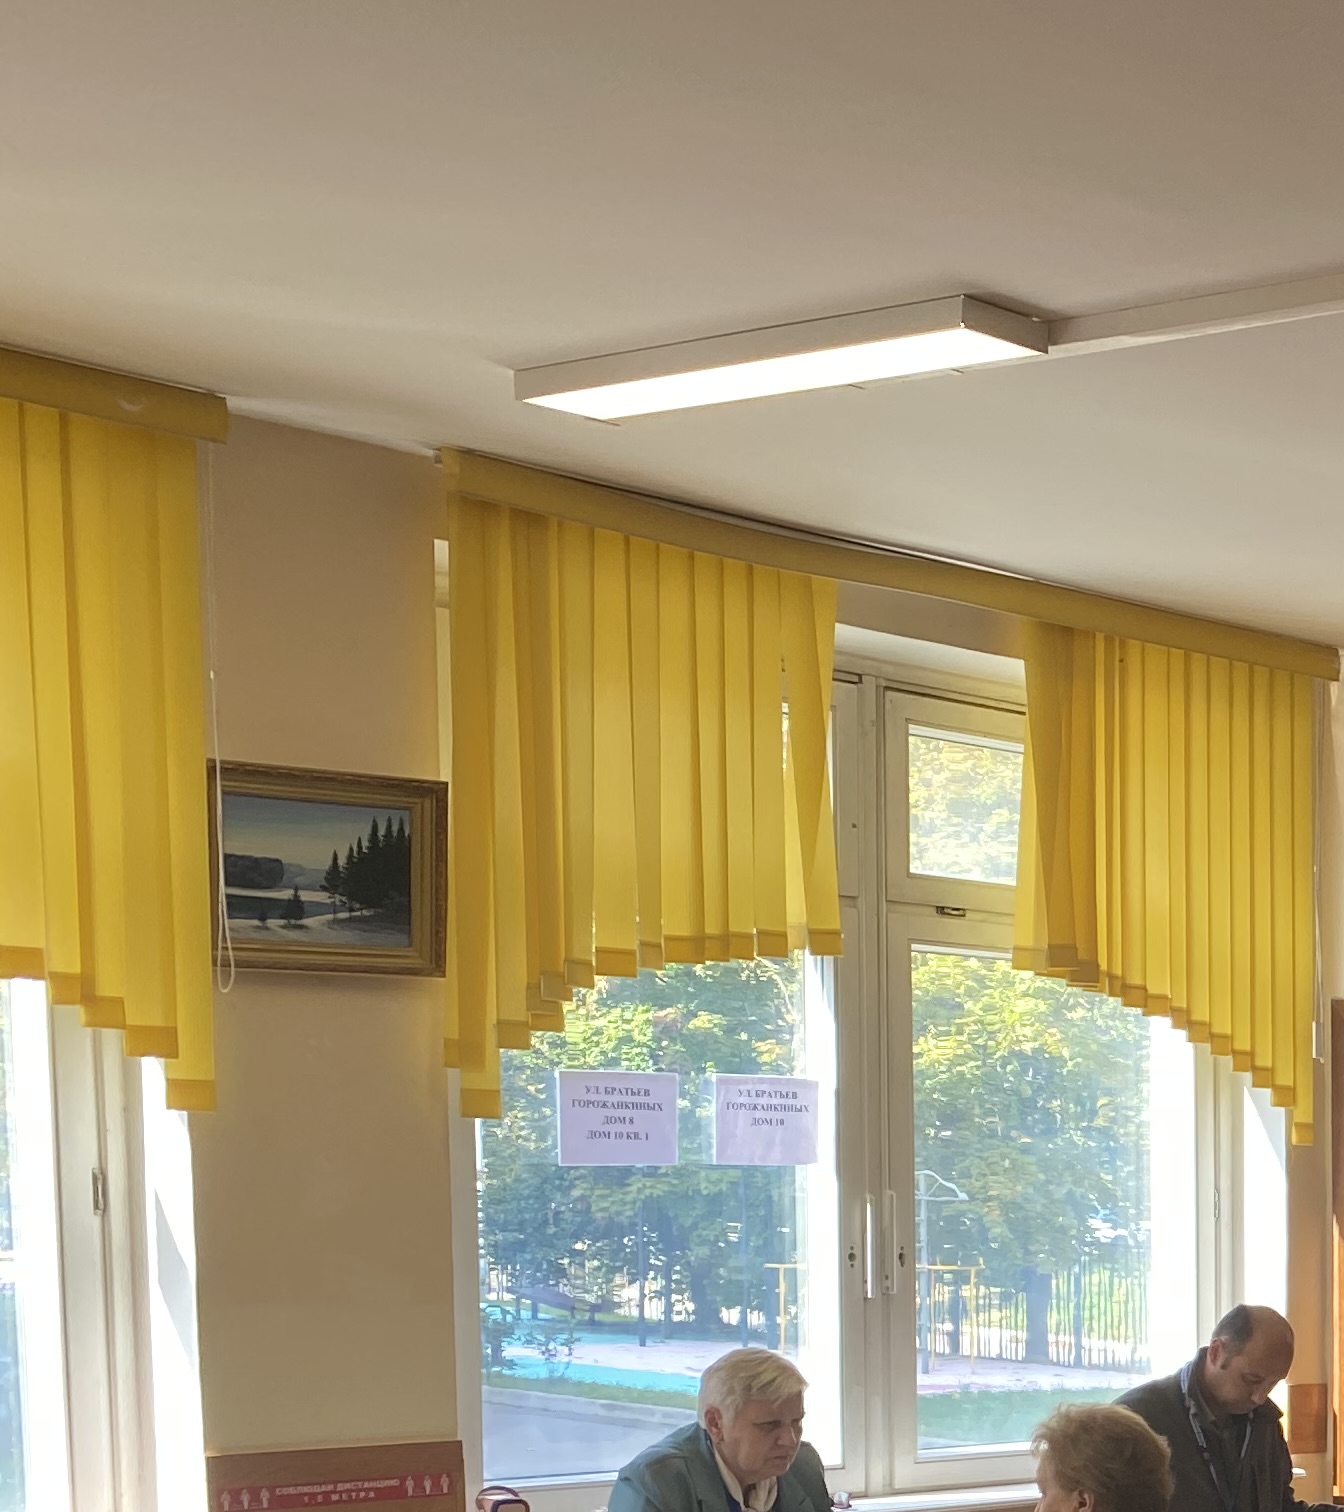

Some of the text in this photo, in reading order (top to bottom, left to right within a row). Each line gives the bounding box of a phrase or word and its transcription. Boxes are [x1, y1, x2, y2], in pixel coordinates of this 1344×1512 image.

[604, 1086, 651, 1097] БРАТЬЕВ
[755, 1089, 798, 1100] БРАТЬЕВ
[571, 1098, 664, 1112] ГОРОЖАНКИНЫХ
[726, 1101, 810, 1113] ГОРОЖАНКИНЫХ
[601, 1115, 635, 1125] ДОМ 8
[750, 1117, 785, 1127] ДОМ 10
[585, 1129, 611, 1140] ДОМ
[614, 1131, 624, 1140] 10
[336, 1478, 401, 1491] ДИСТАНЦИЮ
[330, 1491, 375, 1502] МЕТРА
